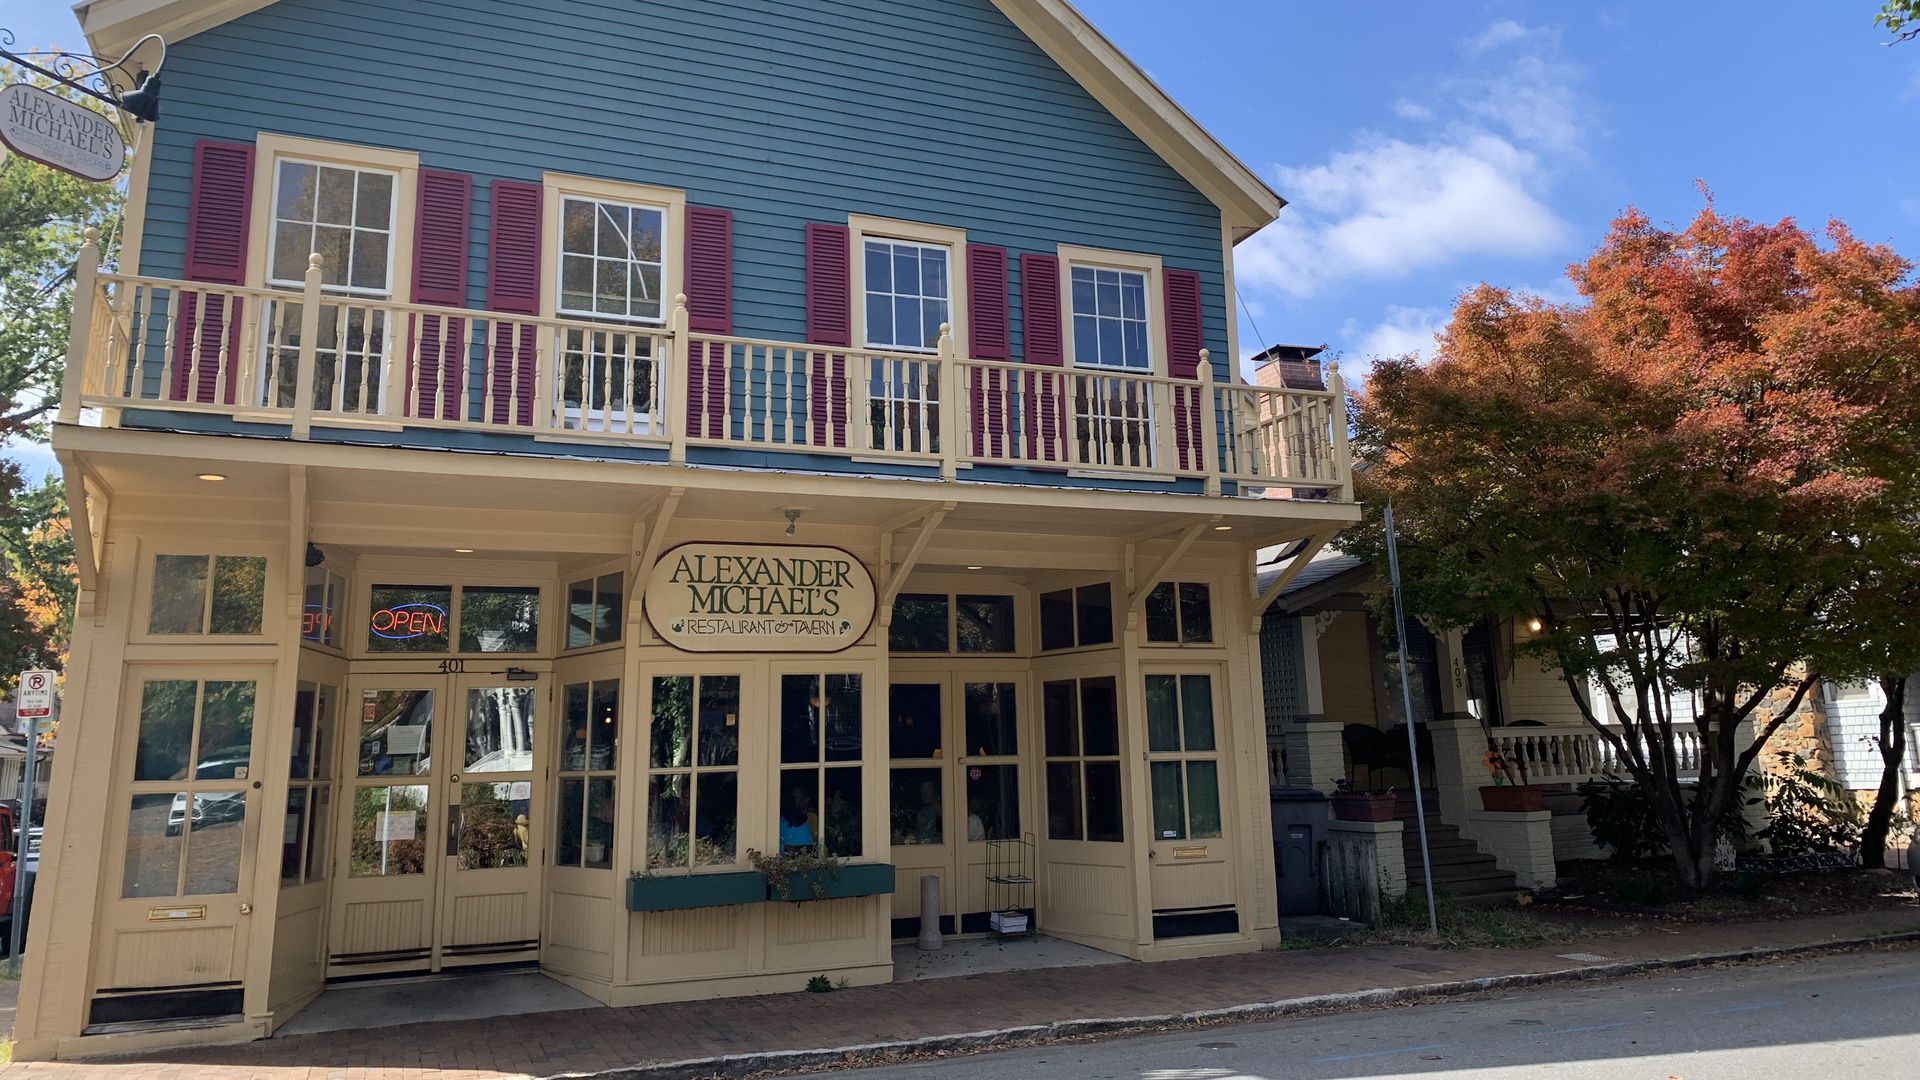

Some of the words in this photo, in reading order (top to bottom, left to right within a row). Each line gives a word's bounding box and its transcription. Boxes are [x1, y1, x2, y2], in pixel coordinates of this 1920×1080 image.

[9, 89, 115, 144] ALEXANDER
[9, 105, 113, 159] MICHAEL'S
[669, 555, 854, 589] ALEXANDER
[687, 585, 840, 616] MICHAEL'S
[372, 609, 443, 633] OPEN
[687, 619, 774, 635] RESTAURANT
[793, 620, 835, 635] TAVERN
[438, 659, 465, 673] 401
[1453, 657, 1462, 688] 403
